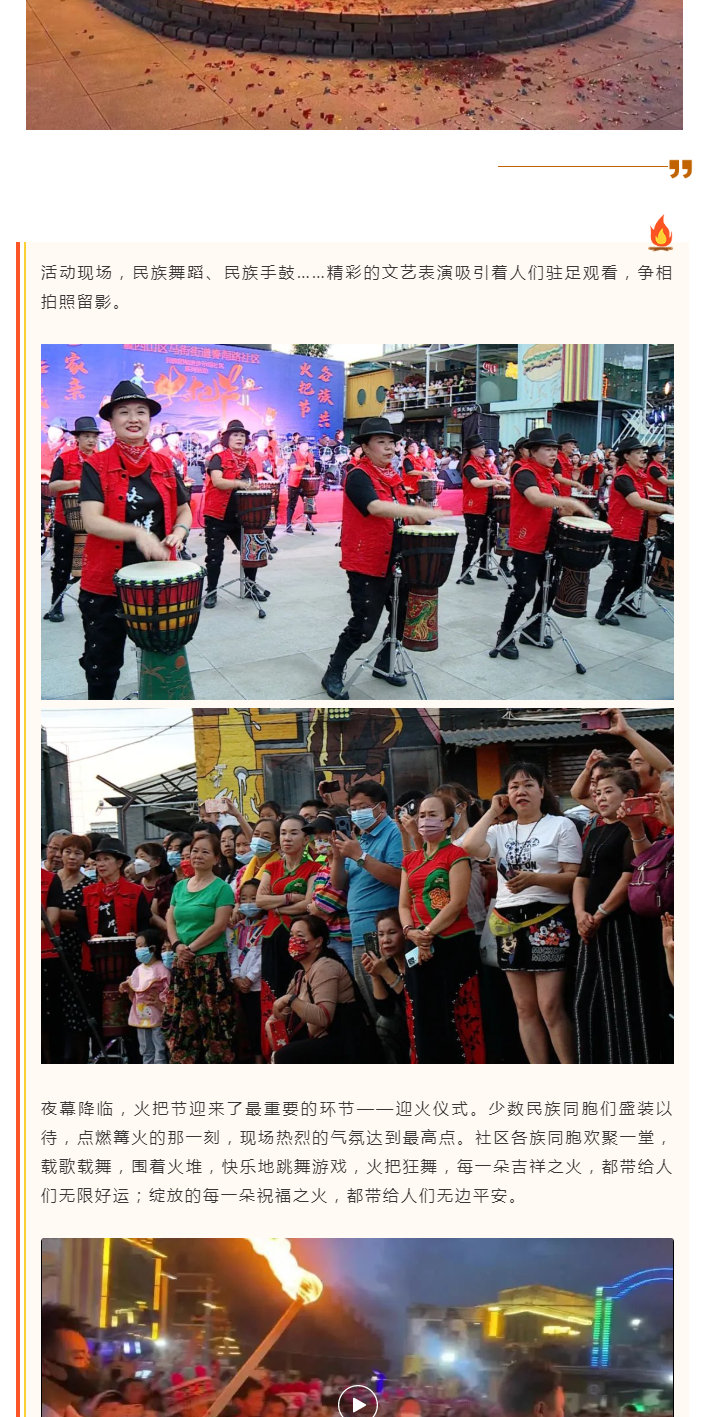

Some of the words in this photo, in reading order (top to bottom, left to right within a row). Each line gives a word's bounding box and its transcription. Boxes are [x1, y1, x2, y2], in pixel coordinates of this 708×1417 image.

[40, 263, 673, 281] 活动现场，民族舞蹈、民族手鼓……精彩的文艺表演吸引着人们驻足观看，争相
[40, 293, 120, 311] 拍照留影。
[40, 1100, 673, 1118] 夜幕降临，火把节迎来了最重要的环节——迎火仪式。少数民族同胞们盛装以
[40, 1128, 667, 1146] 待，点燃篝火的那一刻，现场热烈的气氛达到最高点。社区各族同胞欢聚一堂，
[40, 1157, 673, 1175] 载歌载舞，围着火堆，快乐地跳舞游戏，火把狂舞，每一朵吉祥之火，都带给人
[40, 1187, 517, 1204] 们无限好运；绽放的每一朵祝福之火，都带给人们无边平安。
